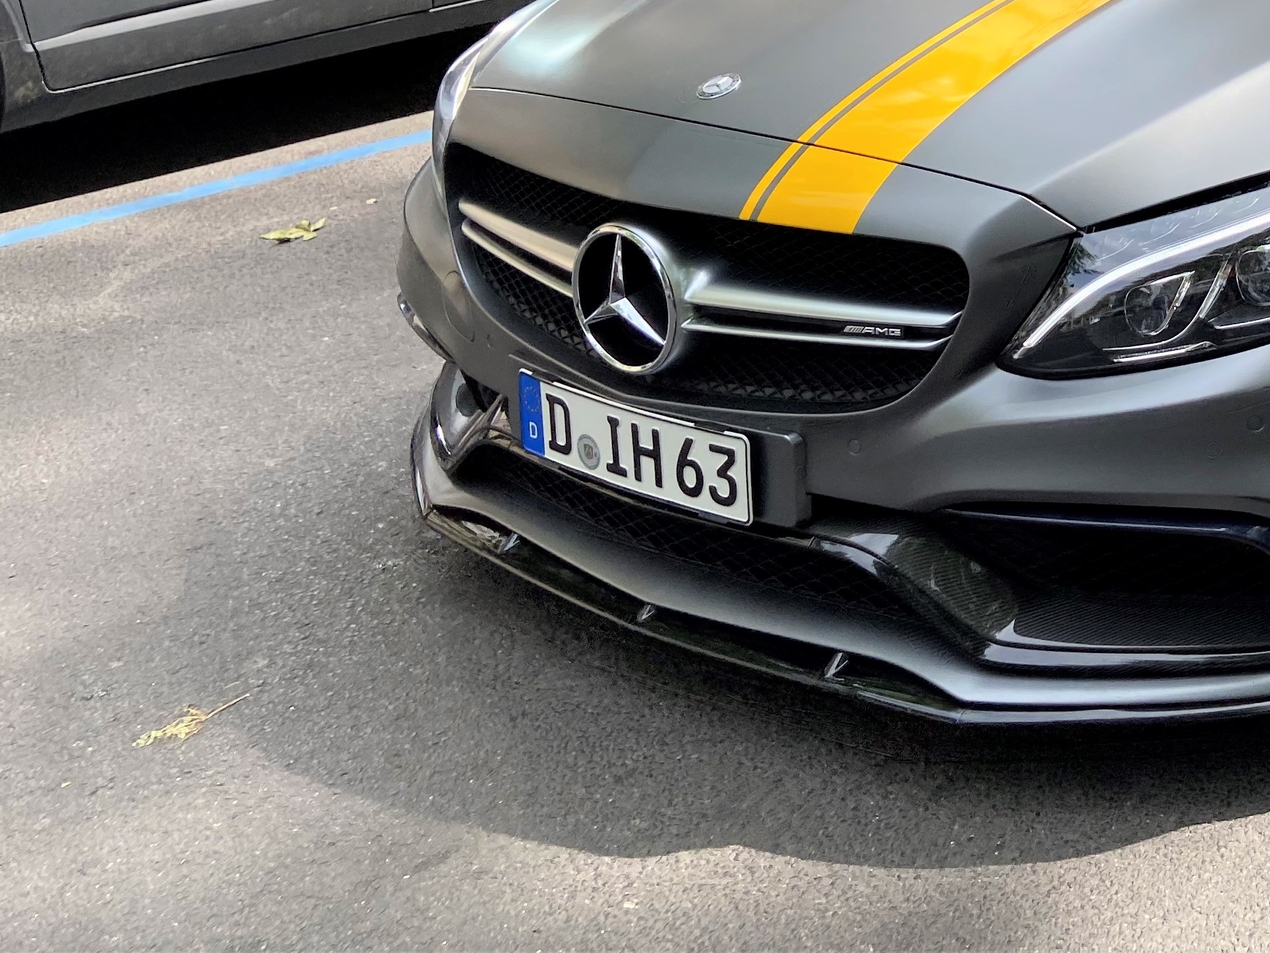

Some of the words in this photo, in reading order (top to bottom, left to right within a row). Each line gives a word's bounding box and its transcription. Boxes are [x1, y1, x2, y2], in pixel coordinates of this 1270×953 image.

[861, 326, 902, 337] AMG
[529, 421, 538, 439] D
[545, 392, 572, 456] D
[606, 414, 664, 489] IH
[676, 437, 738, 507] 63
